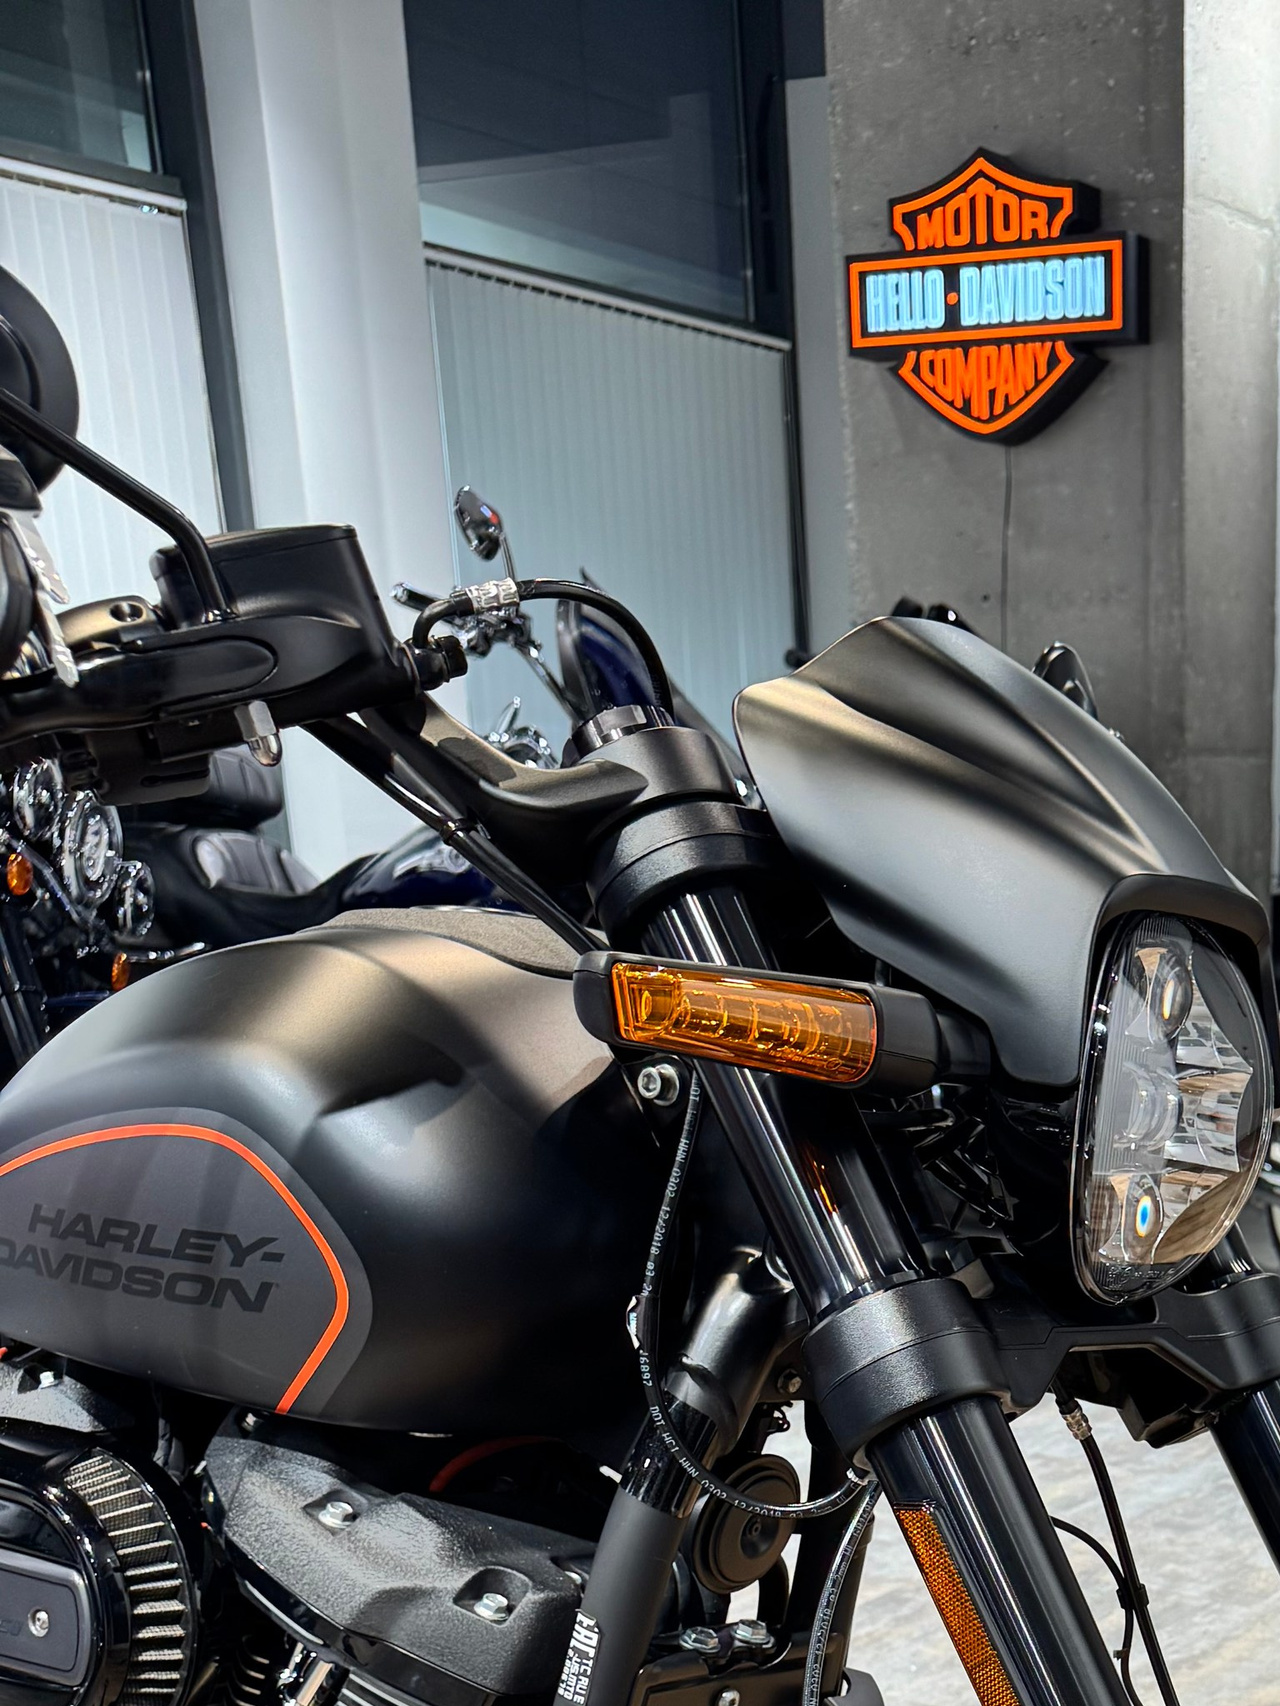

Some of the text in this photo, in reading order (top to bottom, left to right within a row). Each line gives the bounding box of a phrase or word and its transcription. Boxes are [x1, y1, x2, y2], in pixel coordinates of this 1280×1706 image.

[917, 177, 1048, 249] MOTOR
[866, 256, 1105, 333] HELLO DAVIDSON
[920, 341, 1052, 420] COMPANY
[28, 1203, 285, 1268] HARLEY-
